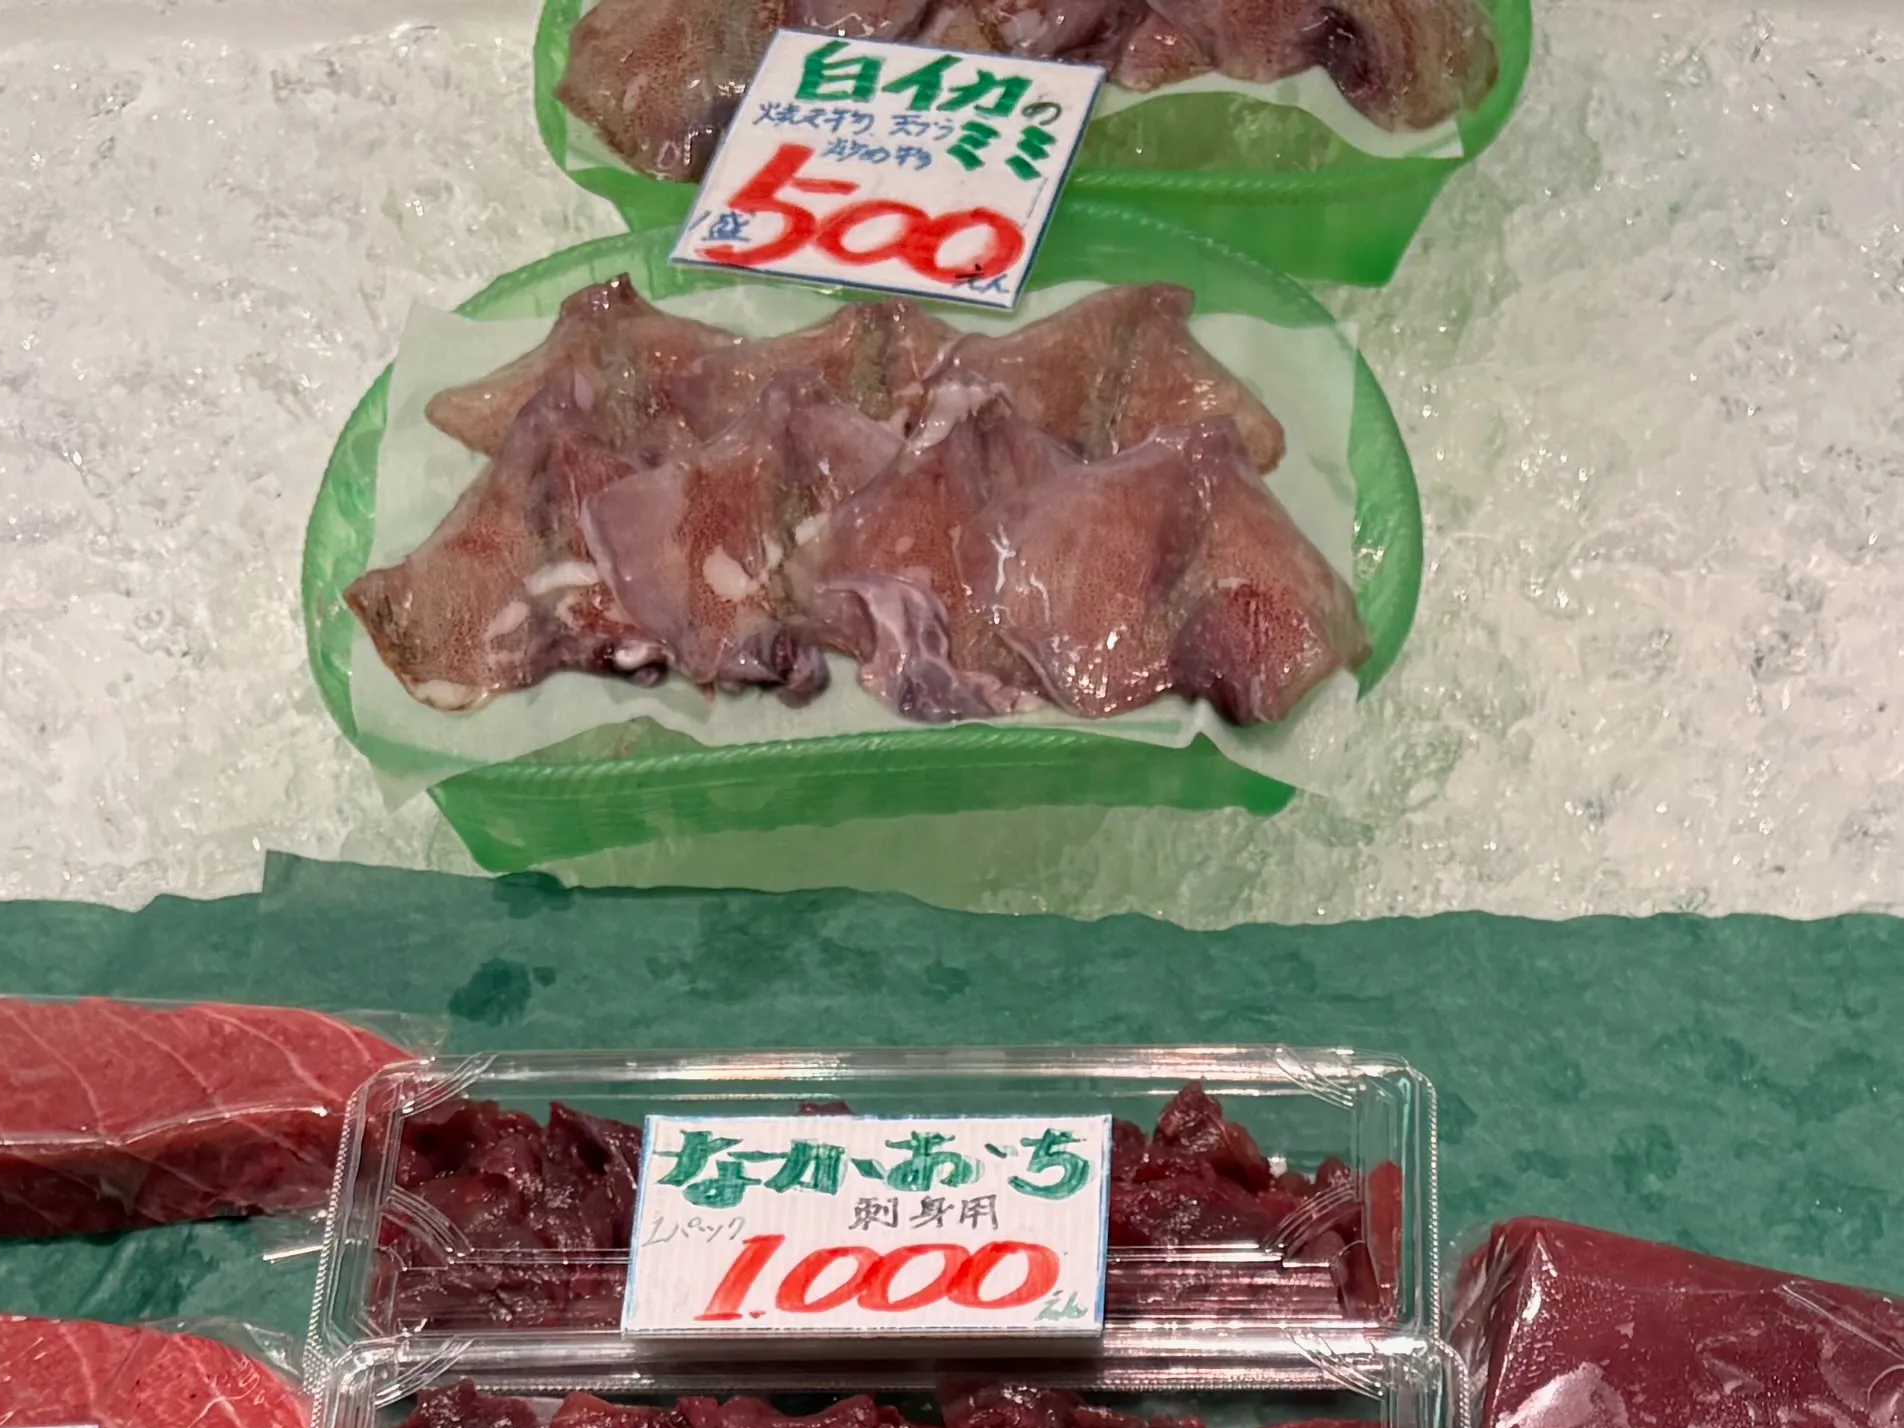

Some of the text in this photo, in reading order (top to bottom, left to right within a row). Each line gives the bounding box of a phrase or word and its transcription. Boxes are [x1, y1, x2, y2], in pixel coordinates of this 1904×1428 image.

[696, 143, 1025, 284] 500
[652, 1127, 1093, 1208] なかおち
[848, 1194, 999, 1232] 刺身用
[1033, 1290, 1088, 1322] えん
